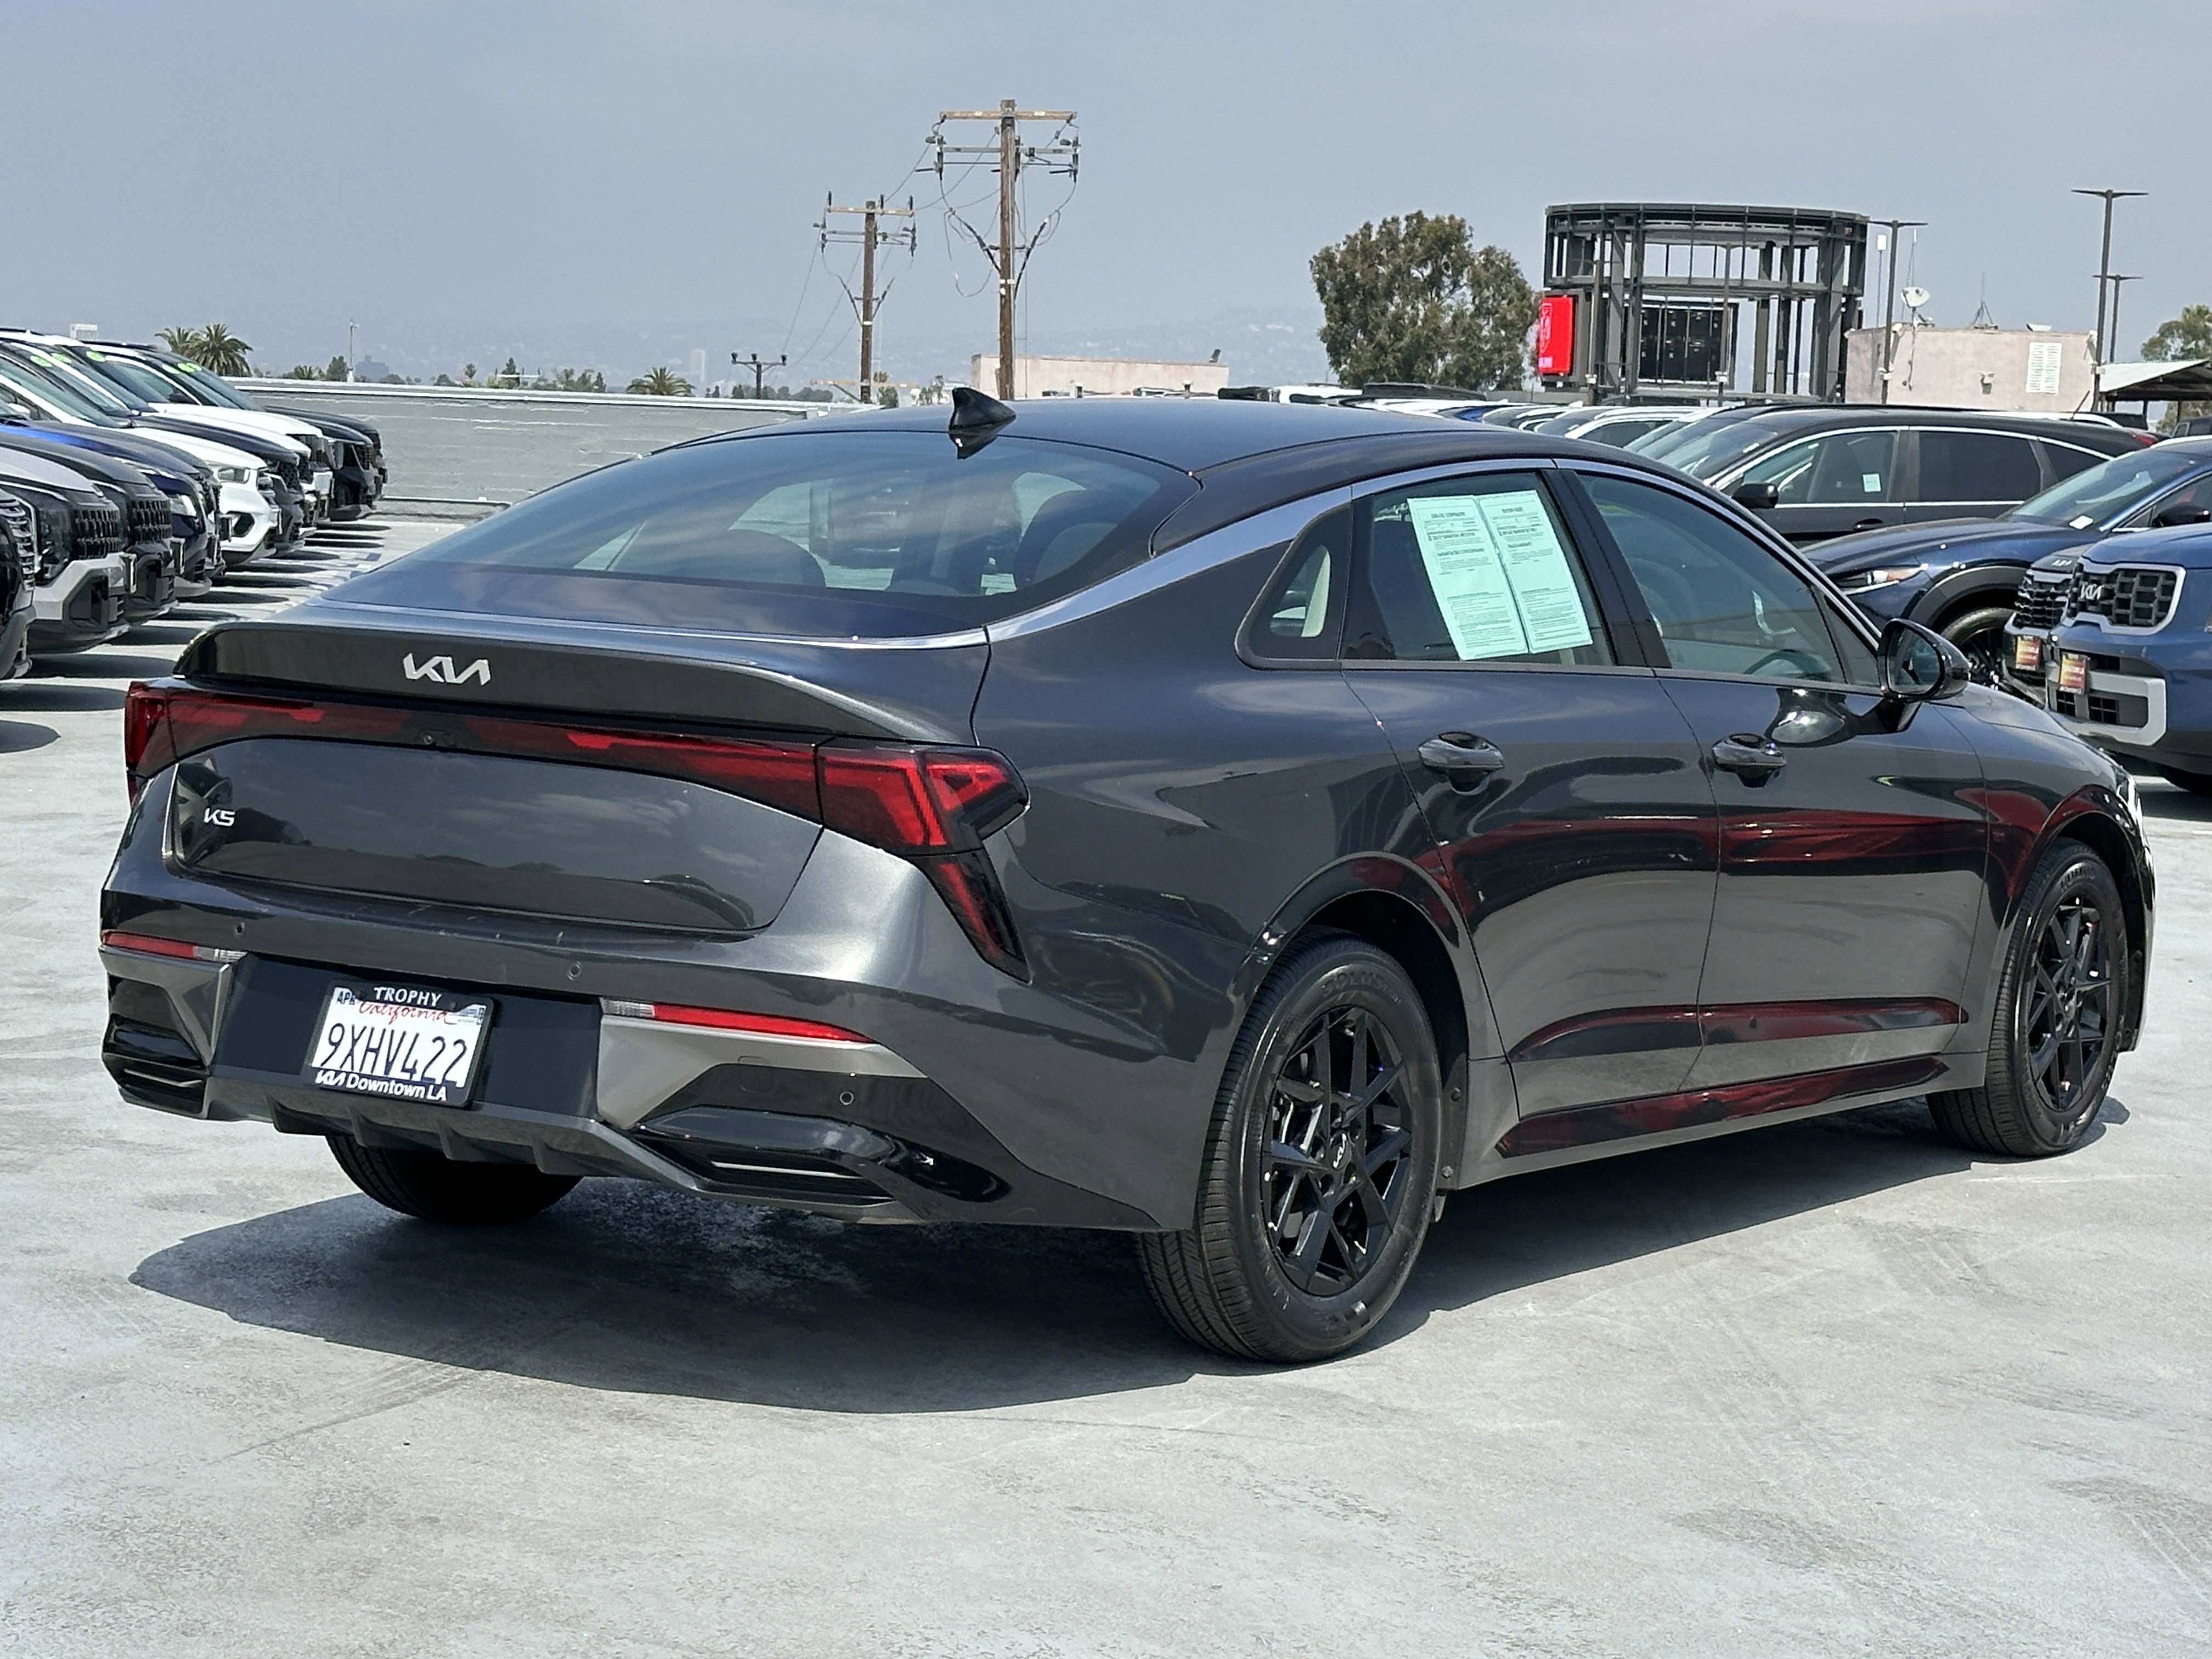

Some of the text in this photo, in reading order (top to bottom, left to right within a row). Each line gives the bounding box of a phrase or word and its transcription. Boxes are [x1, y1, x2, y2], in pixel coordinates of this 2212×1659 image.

[403, 652, 492, 686] KIA
[204, 807, 236, 827] K5
[374, 986, 442, 1007] TROPHY
[321, 1023, 467, 1085] 9XHV422
[314, 1069, 448, 1102] KIA Downtown LA
